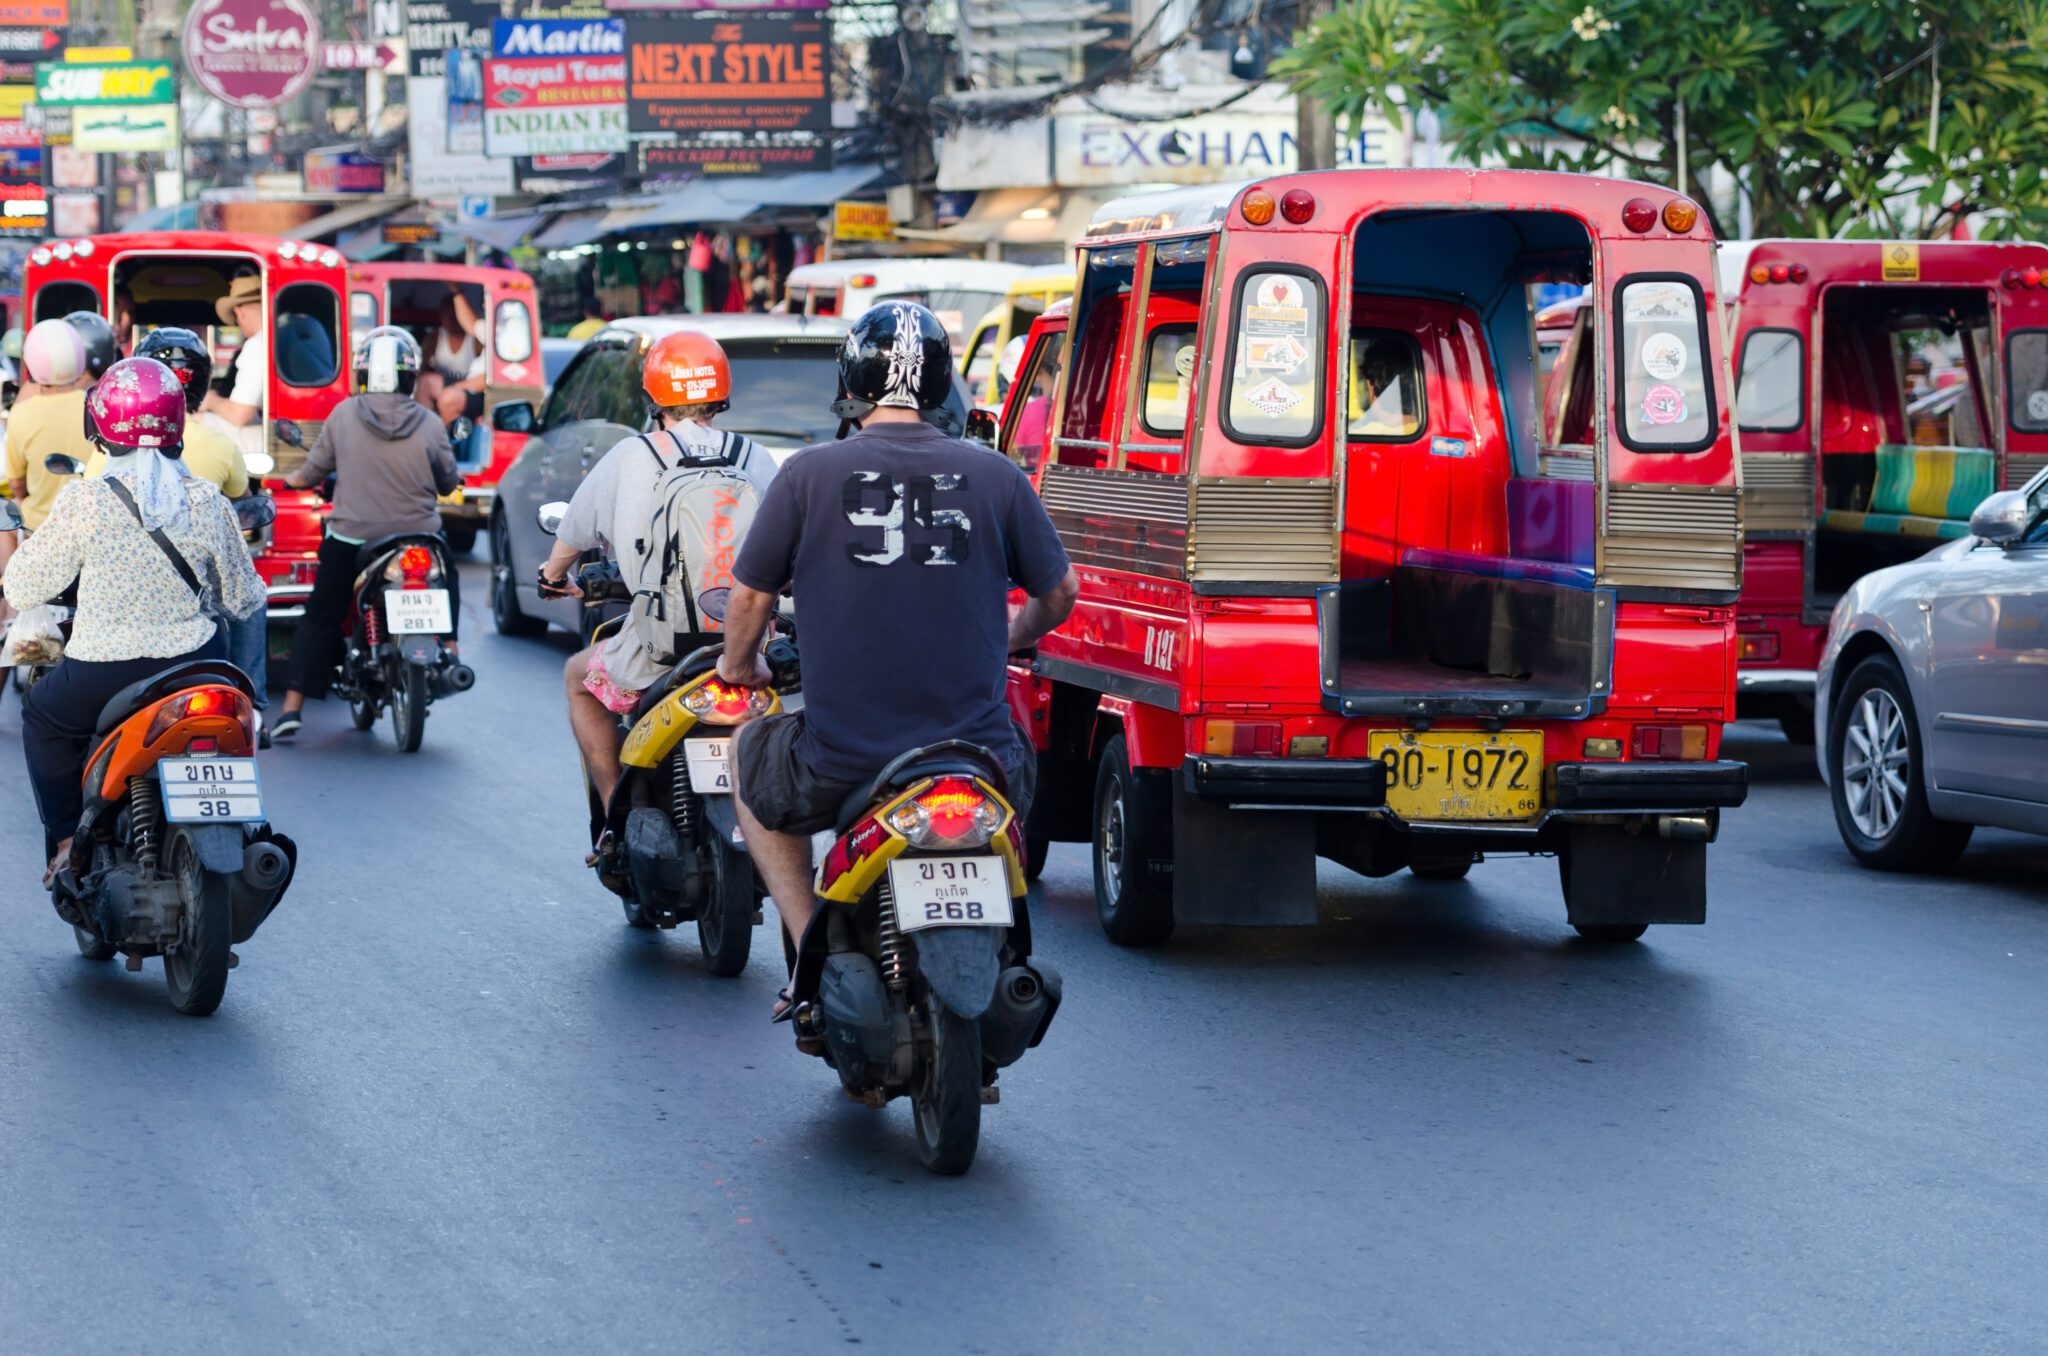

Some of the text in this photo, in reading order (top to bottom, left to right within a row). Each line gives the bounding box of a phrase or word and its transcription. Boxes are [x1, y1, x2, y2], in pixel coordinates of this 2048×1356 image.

[408, 5, 450, 19] www.
[206, 14, 304, 53] Sutra
[503, 24, 624, 54] Martin
[632, 44, 824, 82] NEXT STYLE
[40, 66, 170, 101] SUBWAY
[491, 63, 567, 87] Royal
[494, 110, 589, 134] INDIAN
[693, 365, 716, 377] HOTEL
[843, 471, 971, 567] 95
[405, 618, 433, 629] 281
[1380, 748, 1530, 791] 80-1972
[199, 801, 231, 817] 38
[1518, 800, 1536, 810] 86
[919, 861, 978, 880] ขจก
[935, 884, 968, 901] ภูเก็ต
[924, 902, 984, 920] 268
